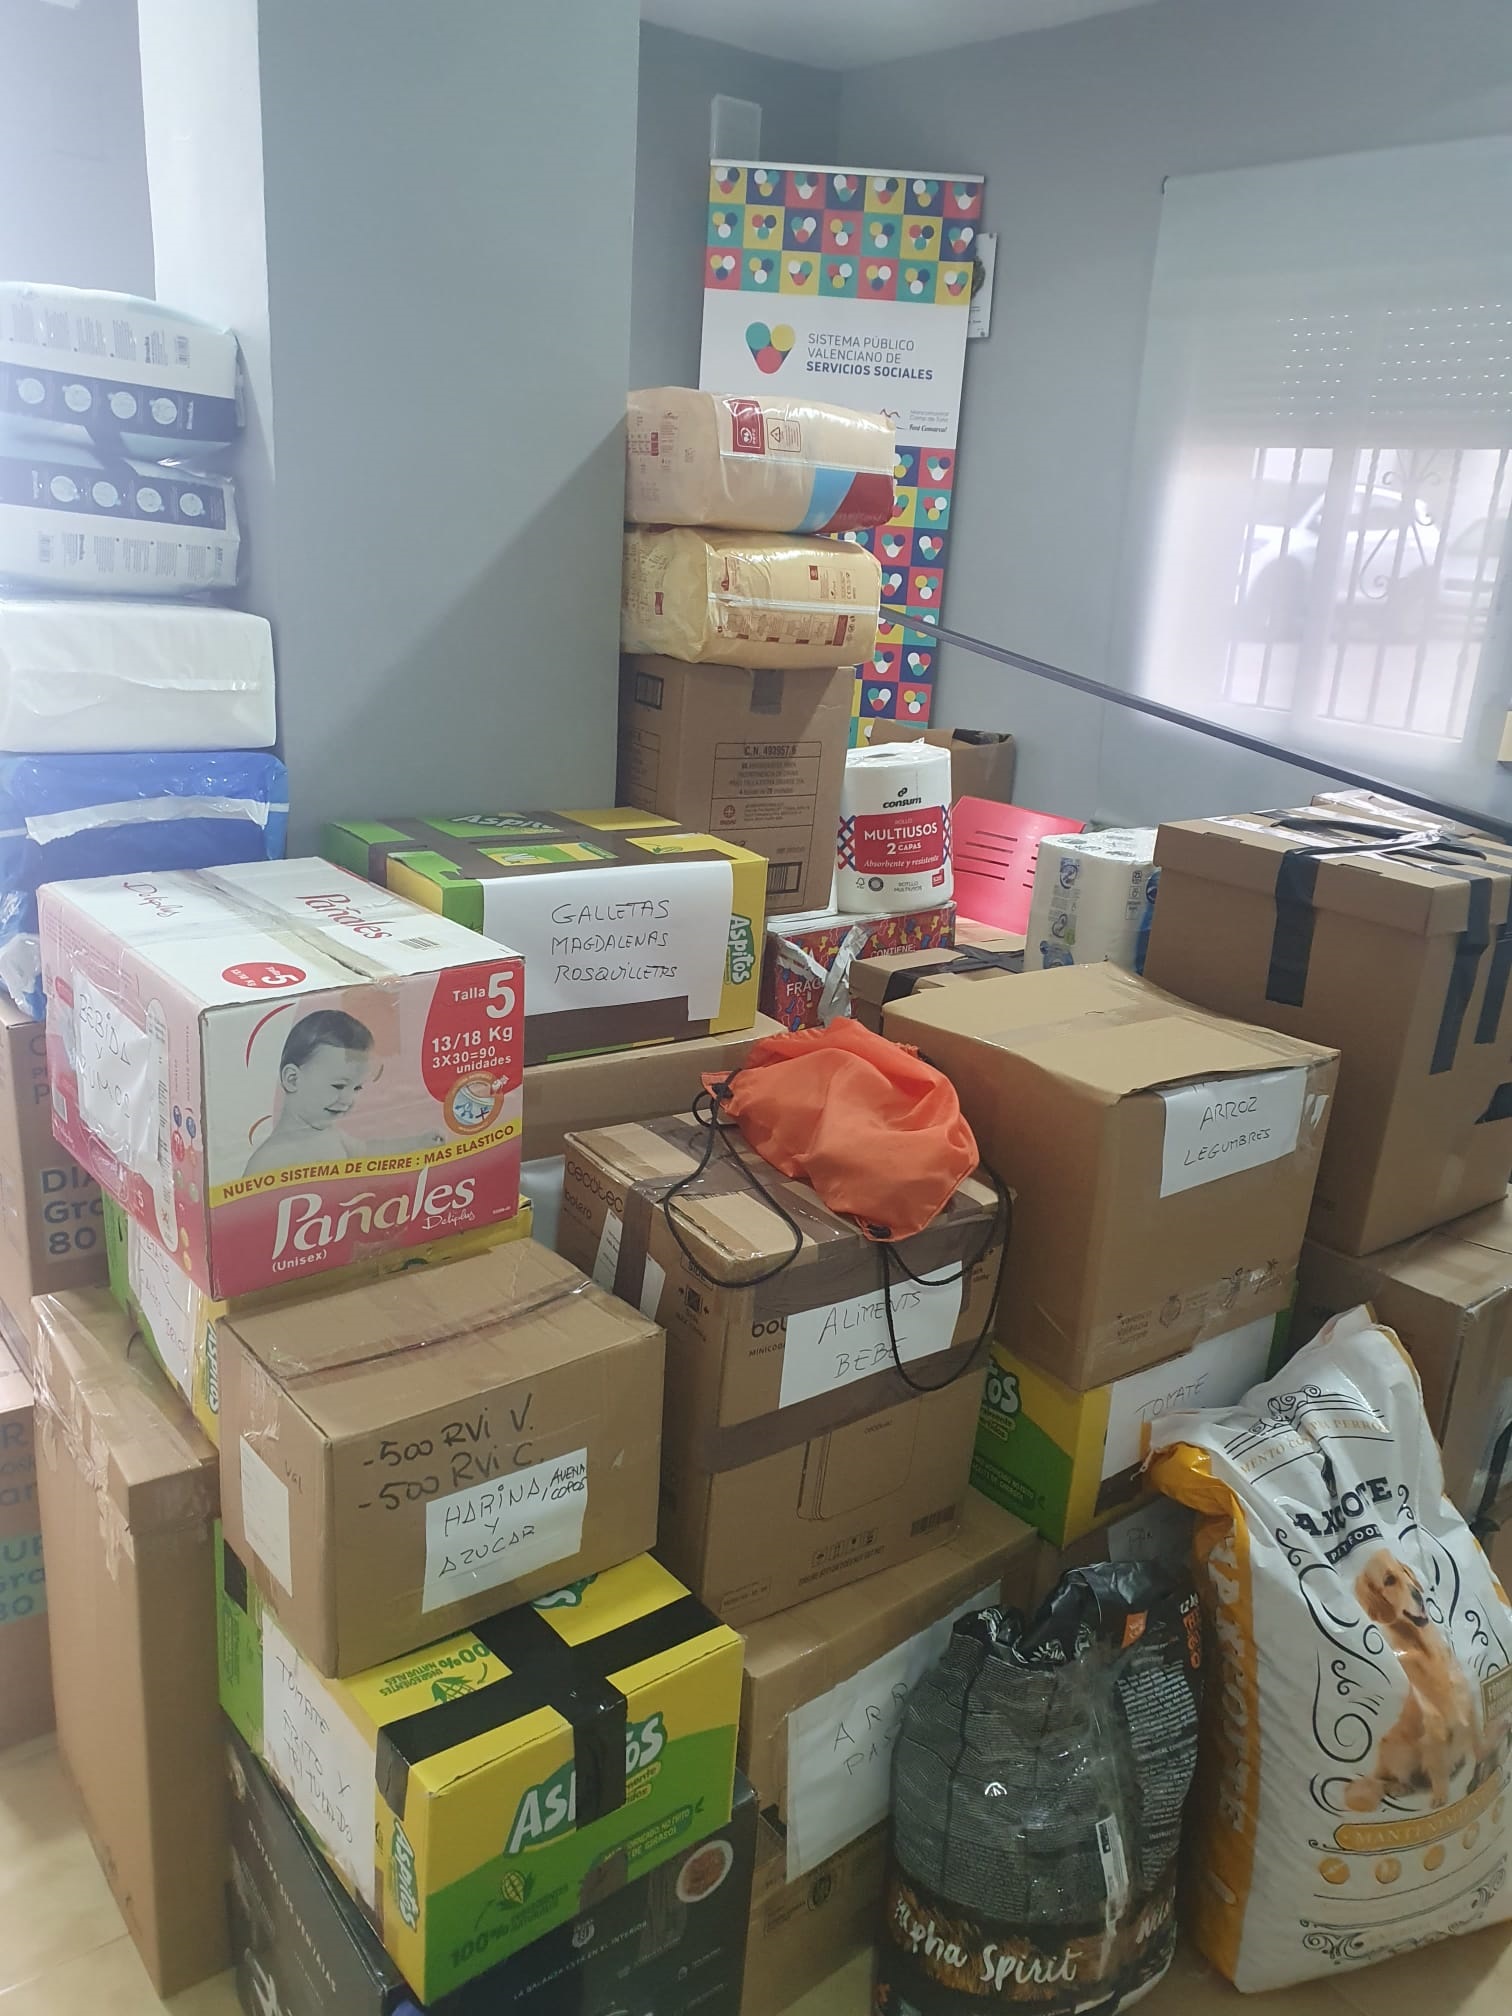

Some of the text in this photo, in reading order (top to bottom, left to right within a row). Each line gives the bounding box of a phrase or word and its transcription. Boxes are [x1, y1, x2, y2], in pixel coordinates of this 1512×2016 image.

[807, 332, 915, 352] SISTEMA PÚBLICO
[807, 347, 902, 365] VALENCIANO DE
[806, 360, 934, 381] SERVICIOS SOCIALES
[882, 796, 923, 809] consum
[864, 821, 939, 841] MULTIUSOS
[886, 841, 923, 856] 2 CAPAS
[863, 859, 906, 869] Absorbente
[295, 893, 394, 940] Pañales
[551, 899, 670, 925] GALLETAS
[551, 930, 669, 956] MAGDALENAS
[727, 914, 757, 986] Aspitos
[260, 973, 300, 985] 5
[452, 970, 517, 1020] Talla 5
[431, 1025, 514, 1054] 13/18 Kg
[431, 1045, 496, 1069] 3X30=90
[455, 1054, 513, 1075] unidades
[1200, 1095, 1258, 1131] ARROZ
[1183, 1128, 1272, 1166] LEGUMBRES
[222, 1174, 277, 1200] NUEVO
[280, 1163, 340, 1184] SISTEMA
[344, 1161, 364, 1176] DE
[366, 1157, 413, 1173] CIERRE
[456, 1124, 515, 1156] ELASTICO
[271, 1165, 477, 1261] Pañales
[271, 1248, 328, 1273] (Unisex)
[1136, 1372, 1209, 1425] TOMATE
[484, 1516, 500, 1535] Y
[438, 1524, 536, 1579] AZUCAR
[379, 1642, 492, 1697] 00% INGREDIENTES
[384, 1661, 438, 1685] NATURALES
[893, 1899, 1083, 1992] Alpha Spirit
